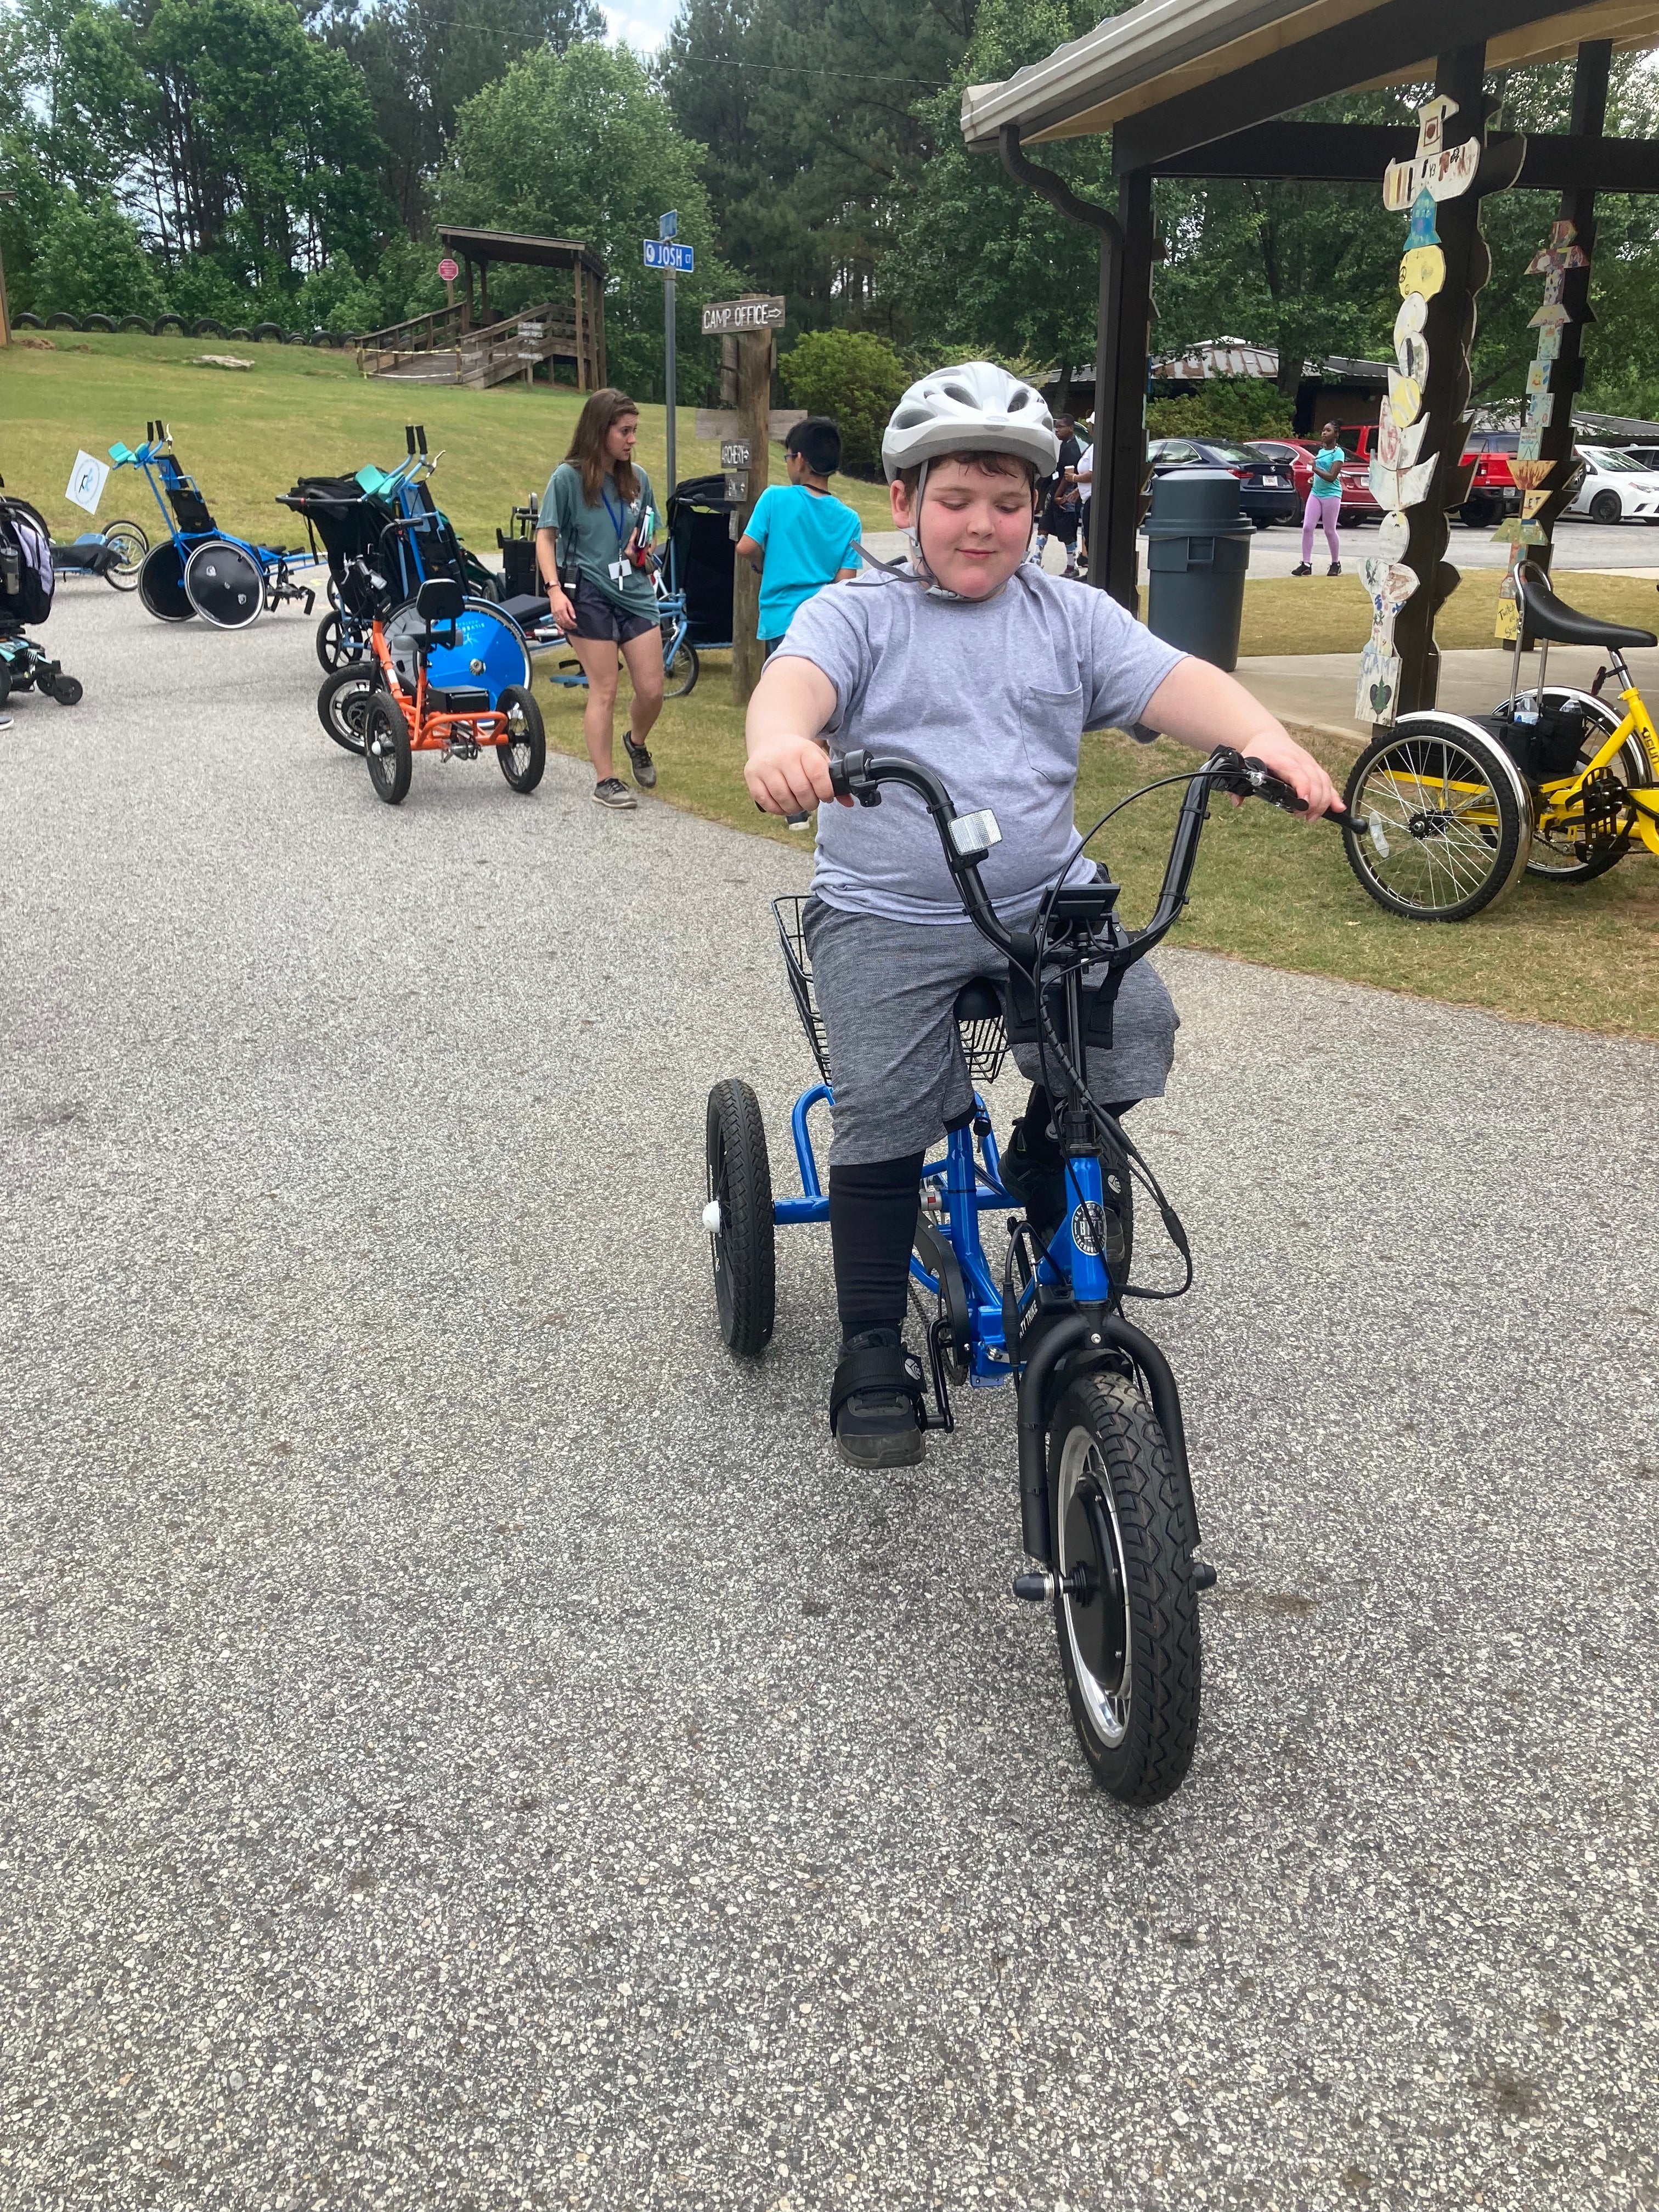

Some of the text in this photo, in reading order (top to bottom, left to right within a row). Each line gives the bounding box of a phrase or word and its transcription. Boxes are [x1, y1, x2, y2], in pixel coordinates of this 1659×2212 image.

[657, 246, 682, 267] JOSH
[703, 304, 769, 329] CAMP OFFICE
[1025, 1299, 1038, 1326] TRIKE
